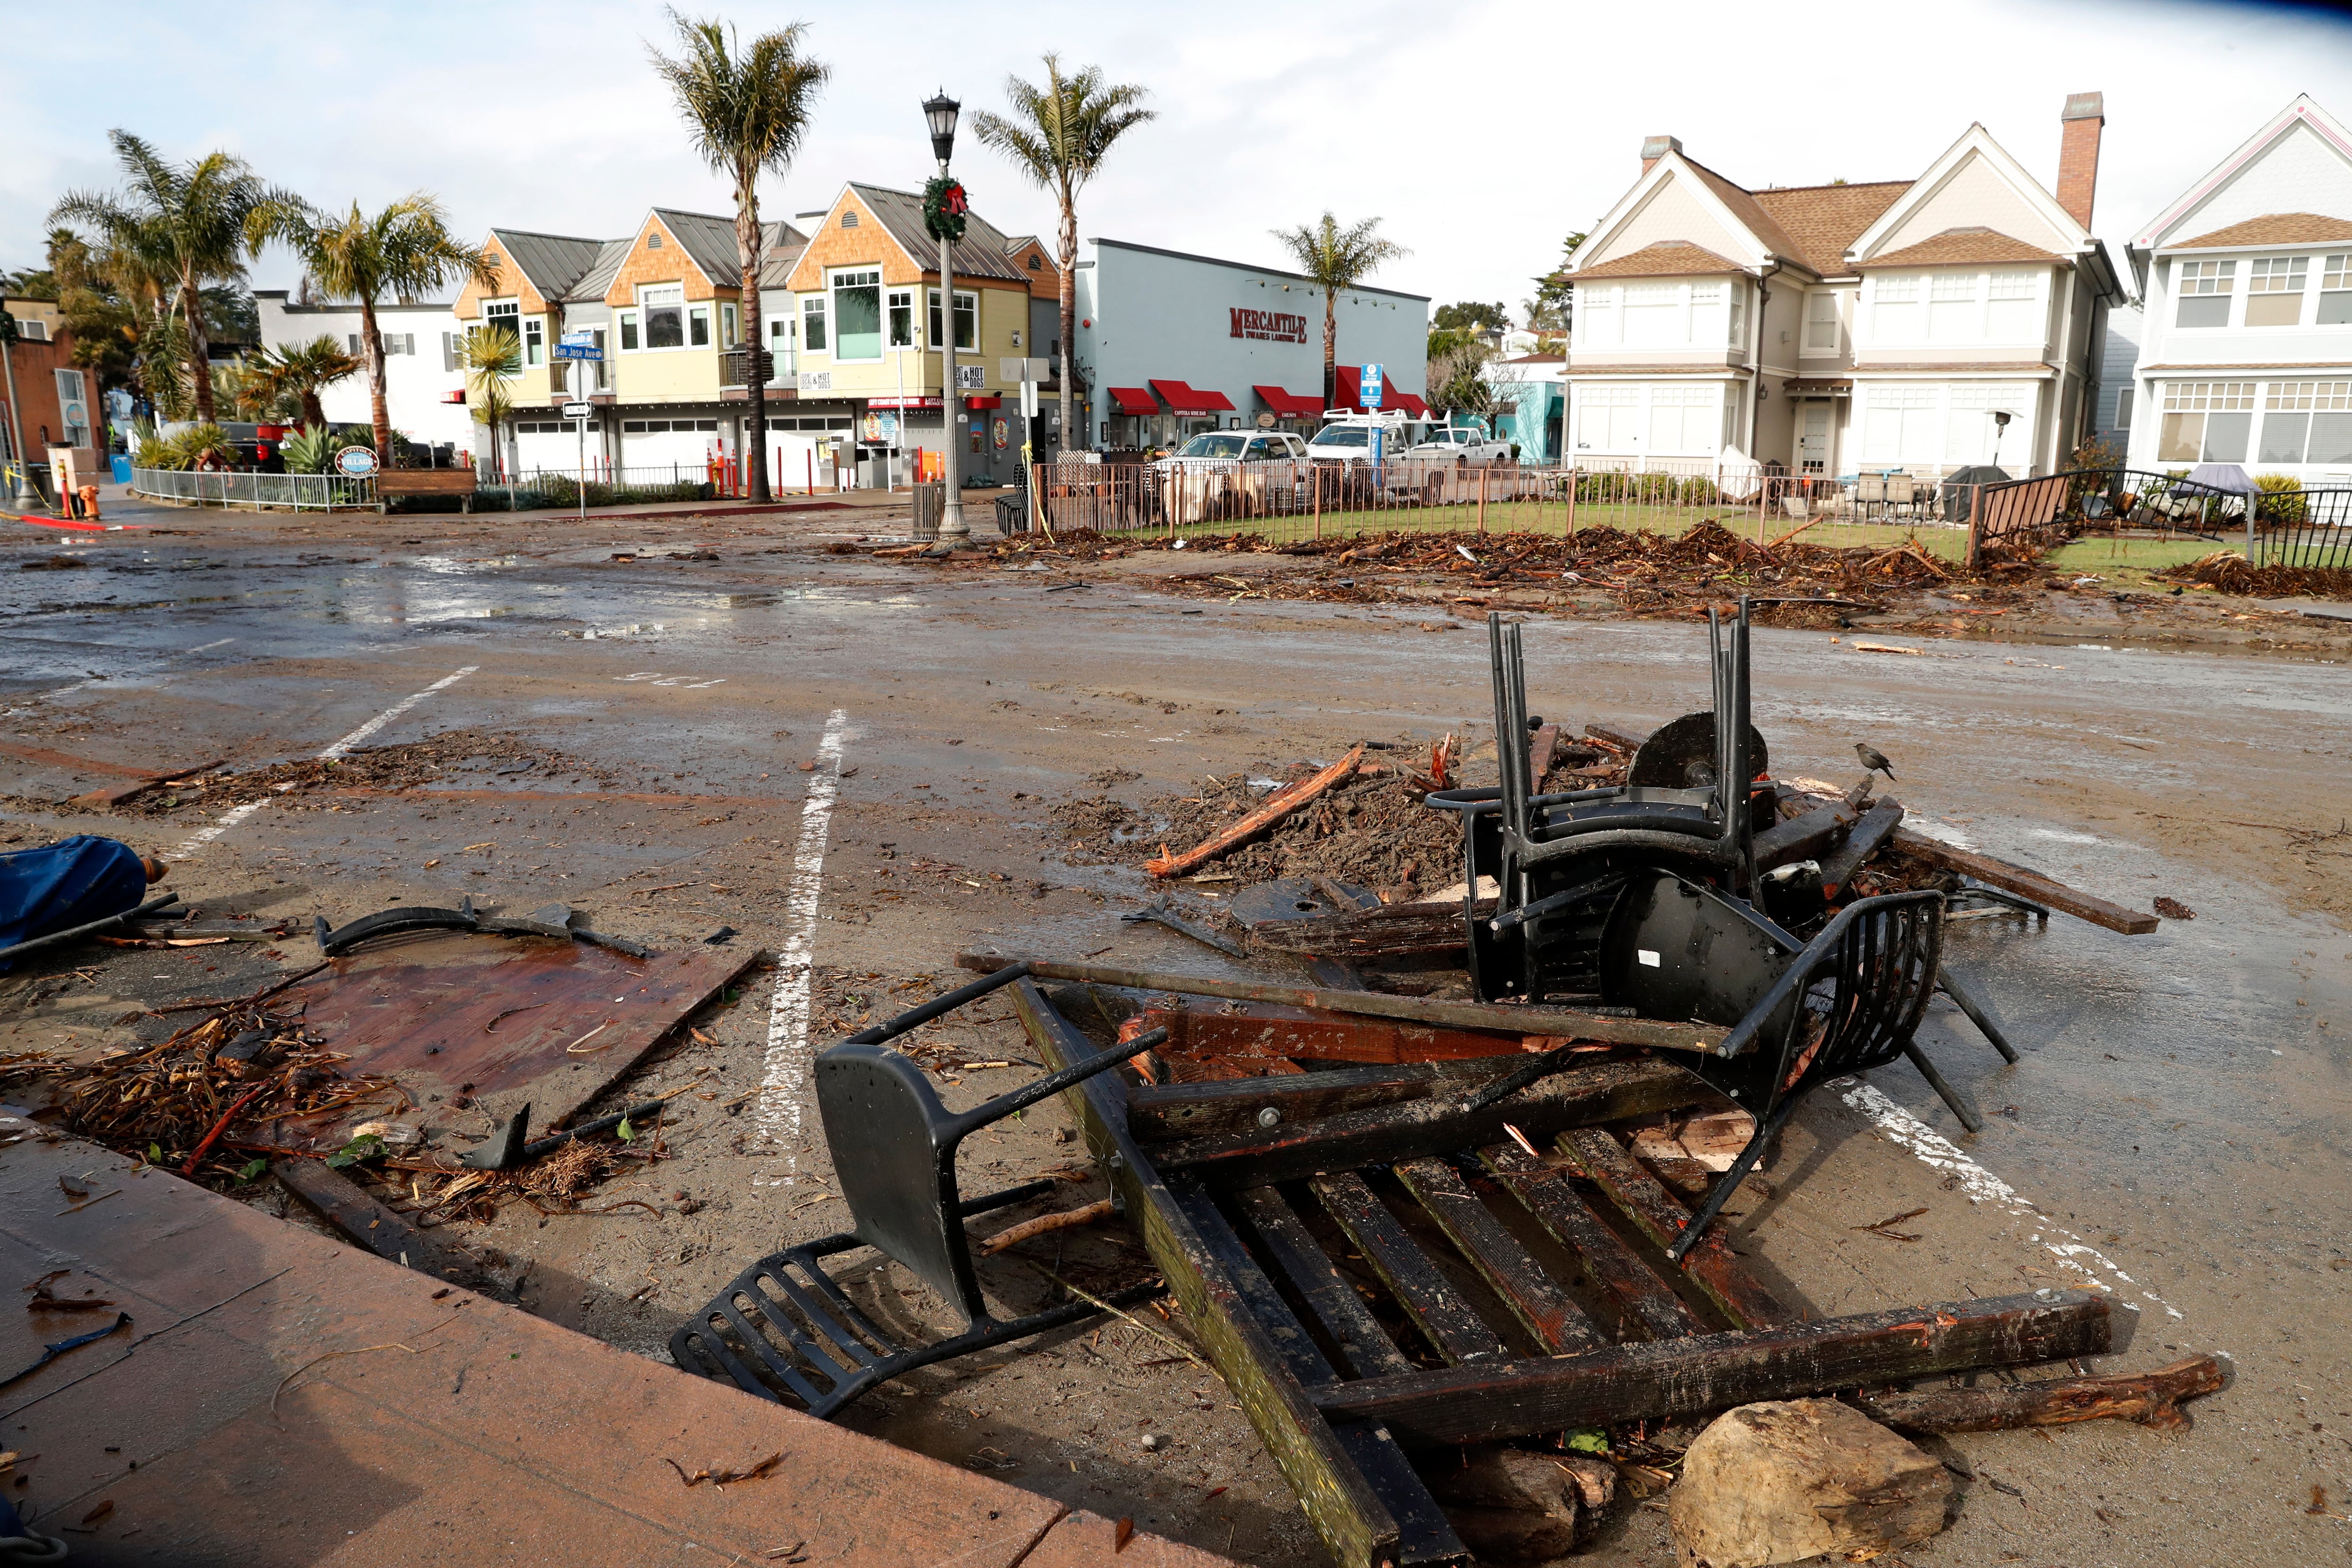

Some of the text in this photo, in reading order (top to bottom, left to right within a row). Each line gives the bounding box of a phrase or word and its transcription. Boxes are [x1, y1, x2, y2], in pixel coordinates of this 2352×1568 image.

[1230, 307, 1307, 343] MERCANTILE
[562, 334, 586, 346] Esplanade
[1271, 333, 1295, 342] LANDING
[556, 345, 595, 358] San Jose Ave
[964, 371, 969, 382] &
[970, 367, 983, 377] HOT
[818, 381, 830, 389] DOGS
[970, 377, 984, 388] DOGS
[341, 466, 376, 475] MERTILE
